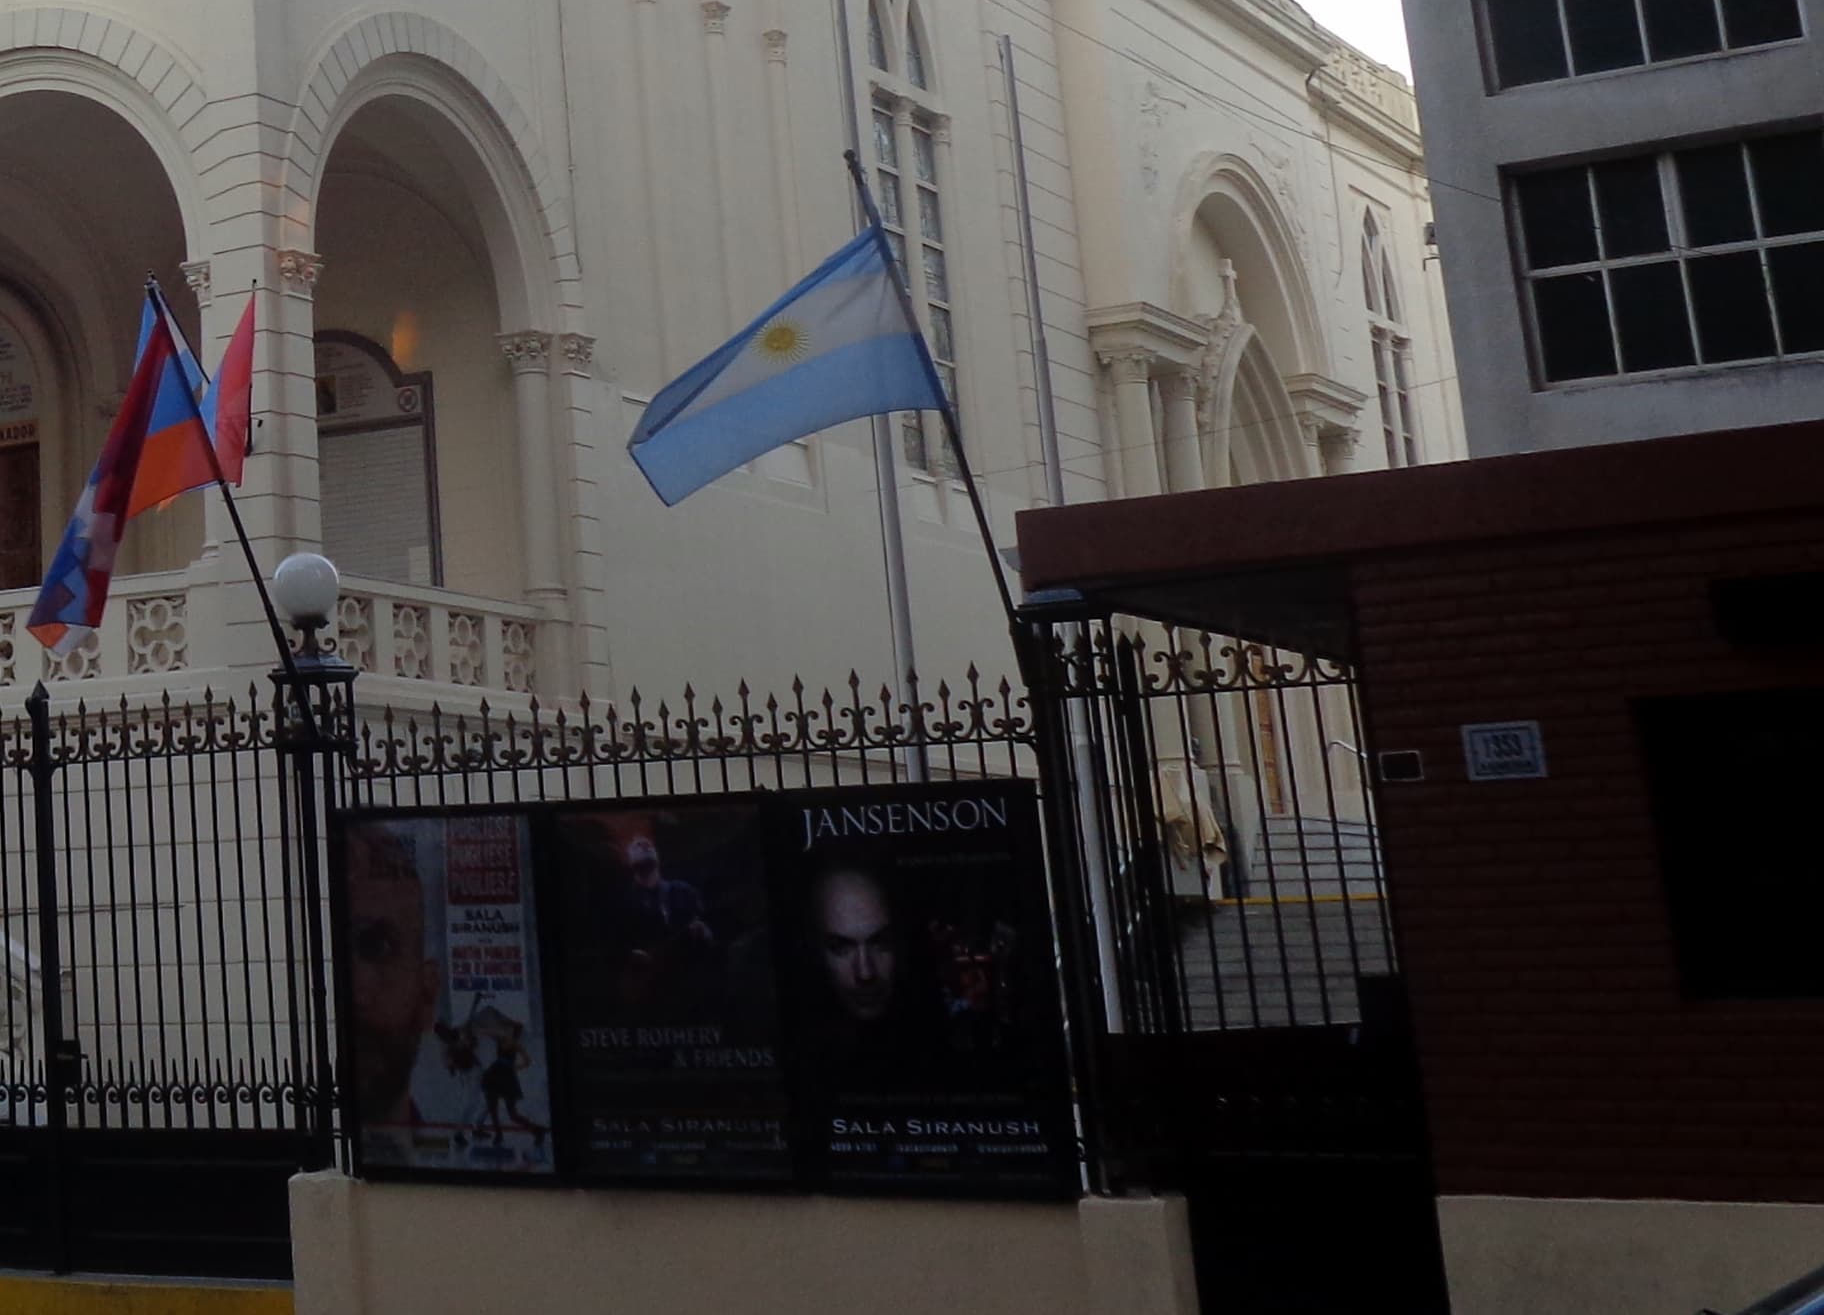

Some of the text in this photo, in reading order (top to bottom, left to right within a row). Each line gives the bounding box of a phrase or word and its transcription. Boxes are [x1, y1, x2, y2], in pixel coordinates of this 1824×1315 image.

[802, 795, 1007, 852] JANSENSON
[578, 1025, 723, 1048] STEVE ROTHERY
[693, 1047, 777, 1069] FRIENDS
[832, 1118, 1041, 1135] SALA SIRANUSH
